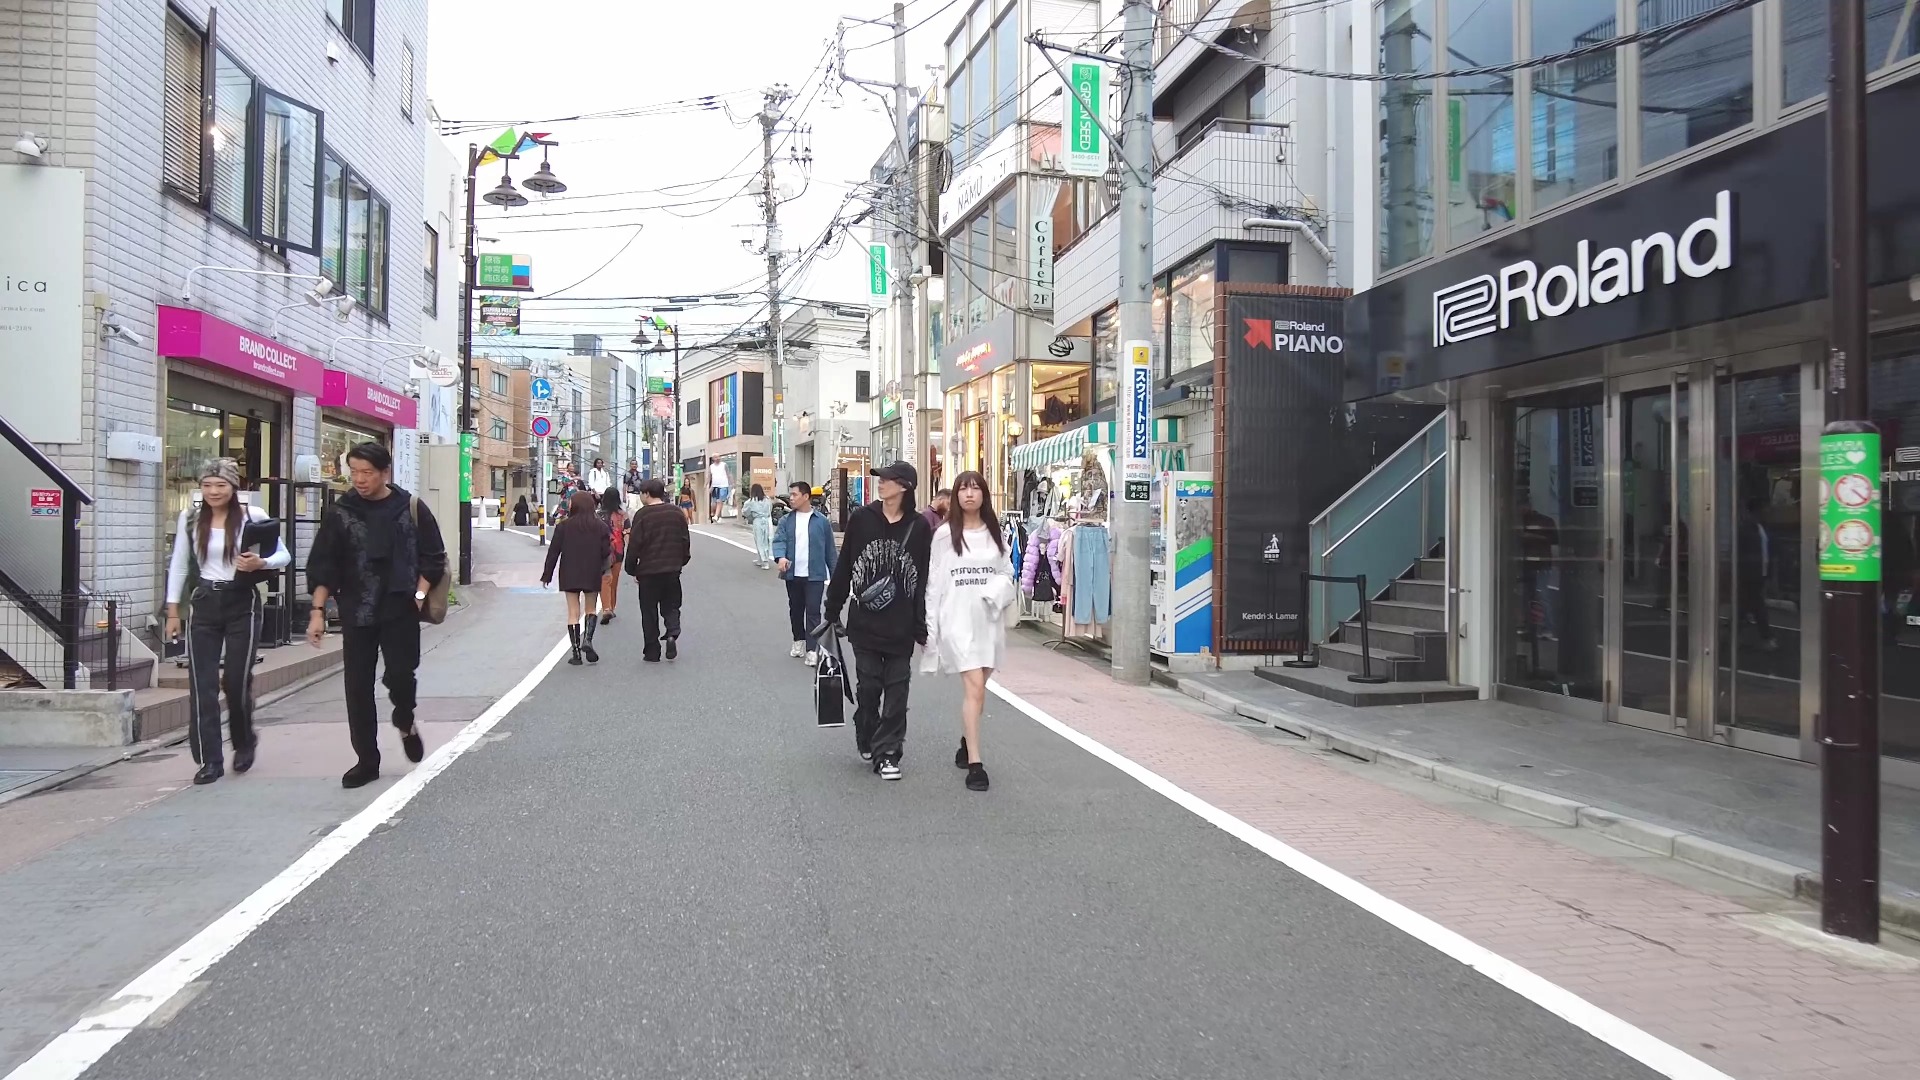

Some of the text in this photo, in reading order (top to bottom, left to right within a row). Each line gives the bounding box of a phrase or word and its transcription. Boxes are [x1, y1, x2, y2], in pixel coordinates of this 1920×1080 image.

[1080, 120, 1092, 151] SEED
[1034, 220, 1048, 288] Coffee
[1500, 190, 1732, 330] Roland
[1033, 294, 1049, 305] 2F
[1289, 320, 1325, 332] Roland
[240, 335, 266, 360] BRAND
[366, 386, 384, 404] BRAND
[1130, 484, 1148, 492] 神宮前
[1275, 612, 1299, 621] Lamar
